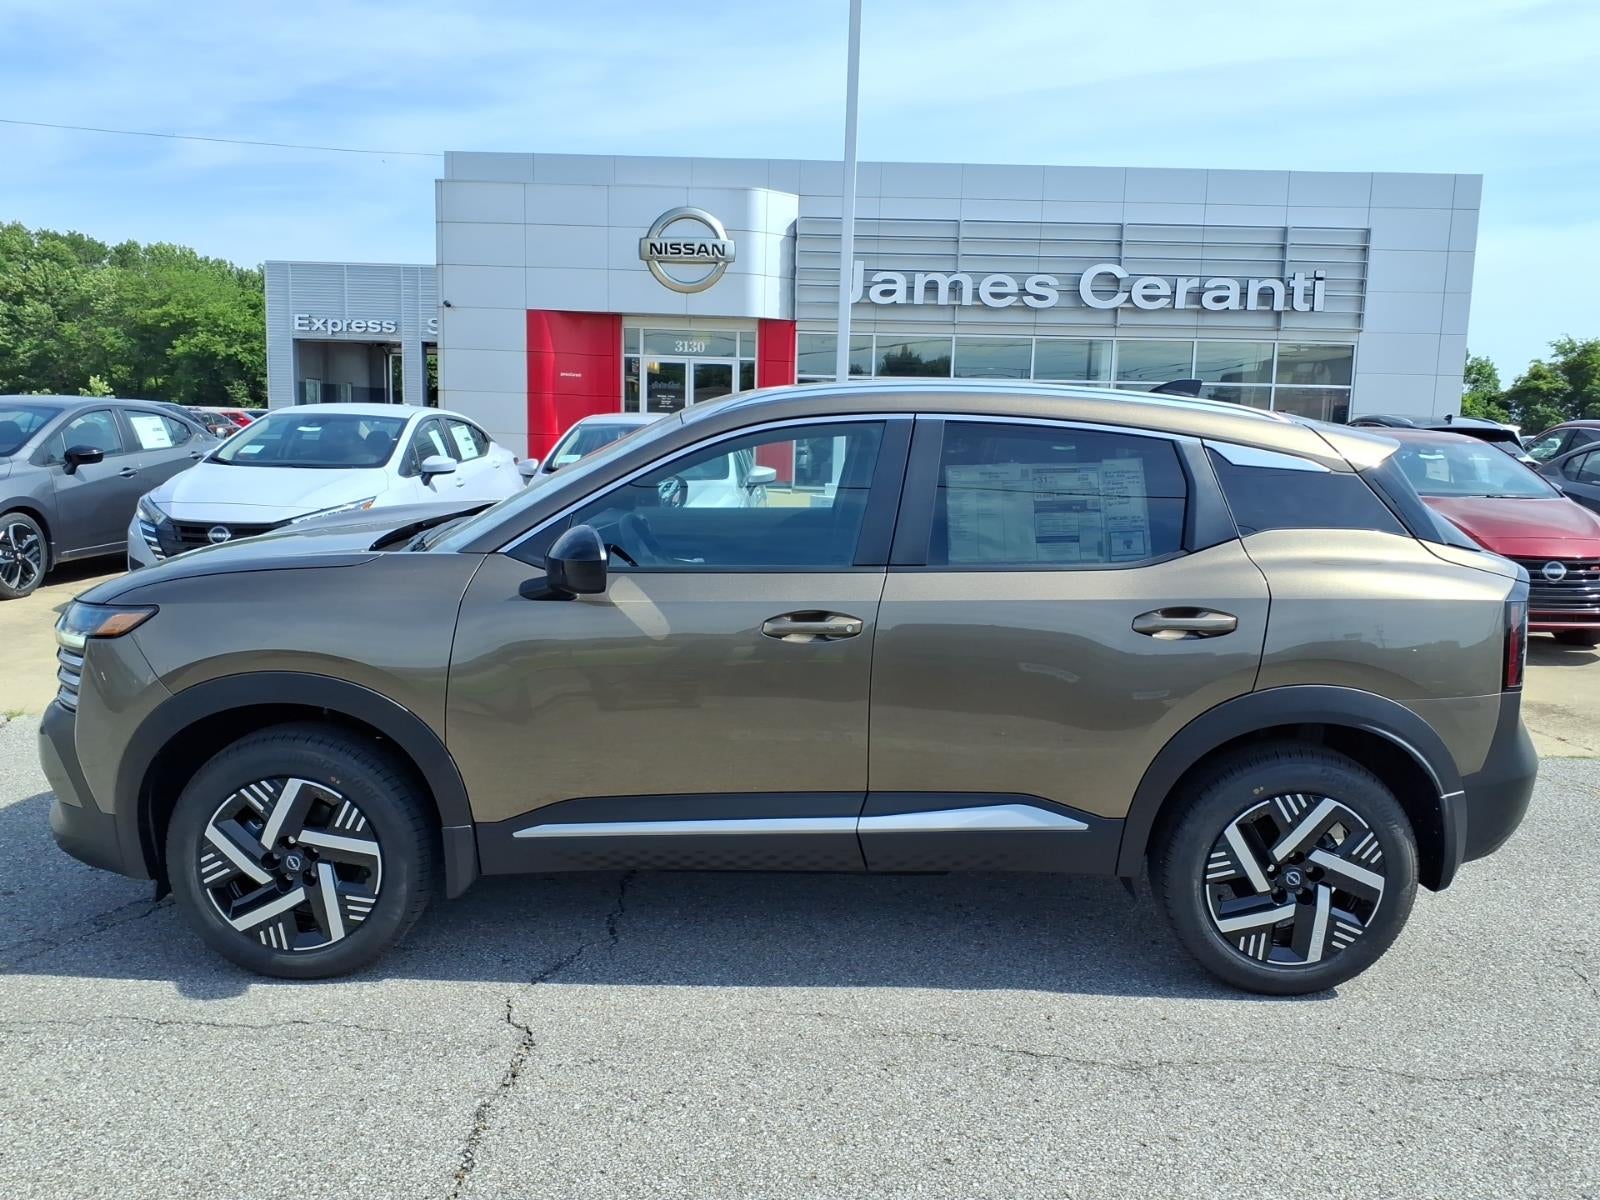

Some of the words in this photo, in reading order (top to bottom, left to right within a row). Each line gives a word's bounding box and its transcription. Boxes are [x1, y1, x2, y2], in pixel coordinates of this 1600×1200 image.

[649, 242, 725, 257] NISSAN
[851, 260, 1059, 309] James
[1079, 263, 1326, 312] Ceranti
[294, 313, 397, 335] Express
[674, 340, 706, 353] 3130
